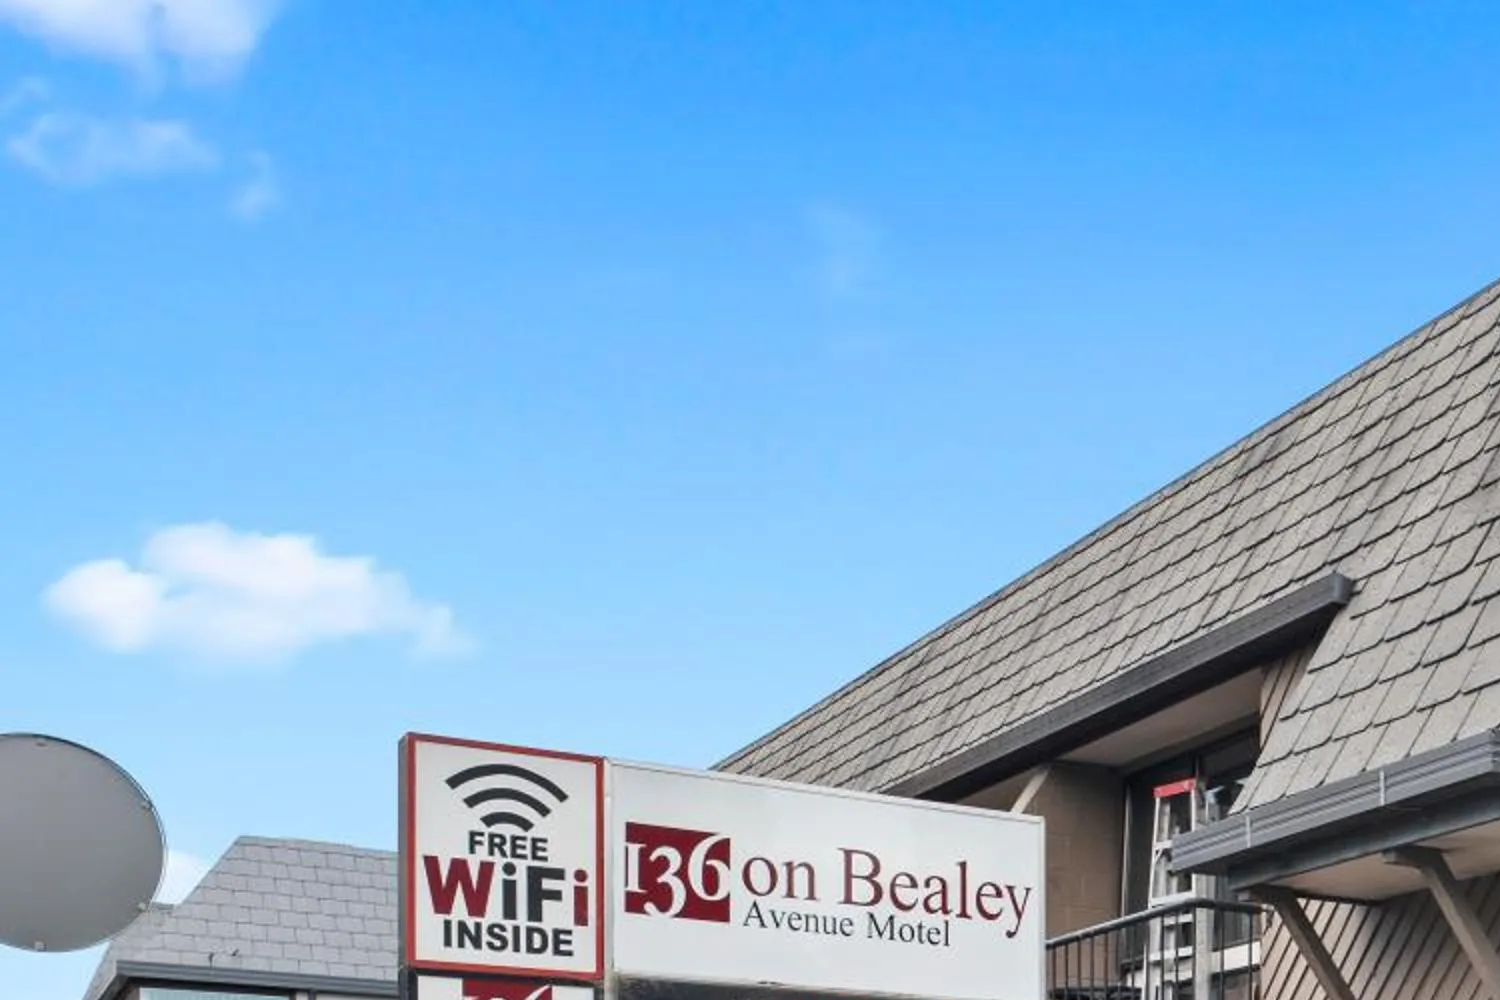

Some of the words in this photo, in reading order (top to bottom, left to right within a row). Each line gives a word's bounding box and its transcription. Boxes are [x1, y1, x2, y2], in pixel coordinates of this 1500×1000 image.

[468, 830, 549, 862] FREE
[423, 855, 589, 927] WiFi
[625, 833, 731, 918] 136
[741, 857, 820, 901] on
[837, 847, 1031, 939] Bealey
[443, 919, 574, 957] INSIDE
[743, 901, 855, 938] Avenue
[867, 912, 951, 947] Motel
